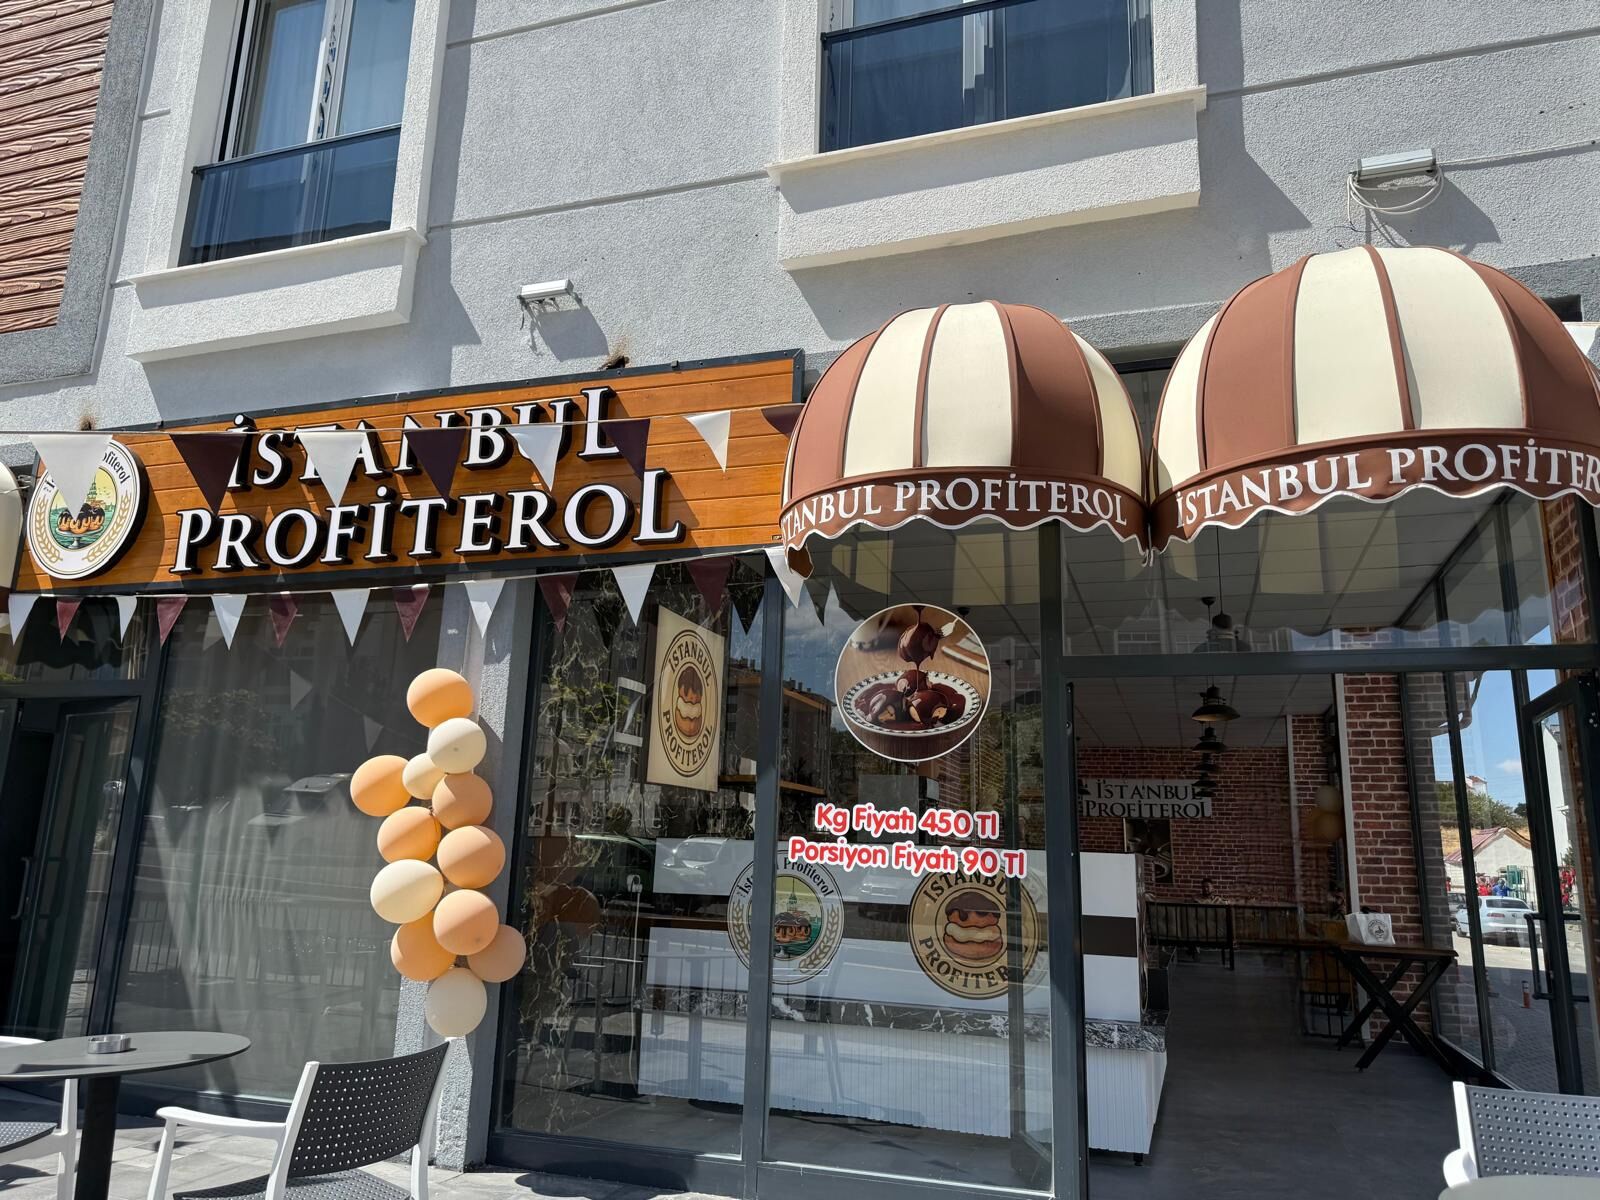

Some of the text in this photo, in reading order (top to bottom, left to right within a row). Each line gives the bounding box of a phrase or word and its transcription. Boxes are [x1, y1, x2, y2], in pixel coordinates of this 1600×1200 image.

[893, 473, 1127, 526] PROFİTEROL
[1176, 453, 1372, 528] İSTANBUL
[170, 467, 683, 575] PROFİTEROL
[817, 804, 848, 833] Kg
[855, 805, 915, 835] Fiyatı
[921, 809, 971, 837] 450
[791, 838, 886, 870] Porsiyon
[895, 844, 956, 874] Fiyatı
[963, 850, 998, 874] 90
